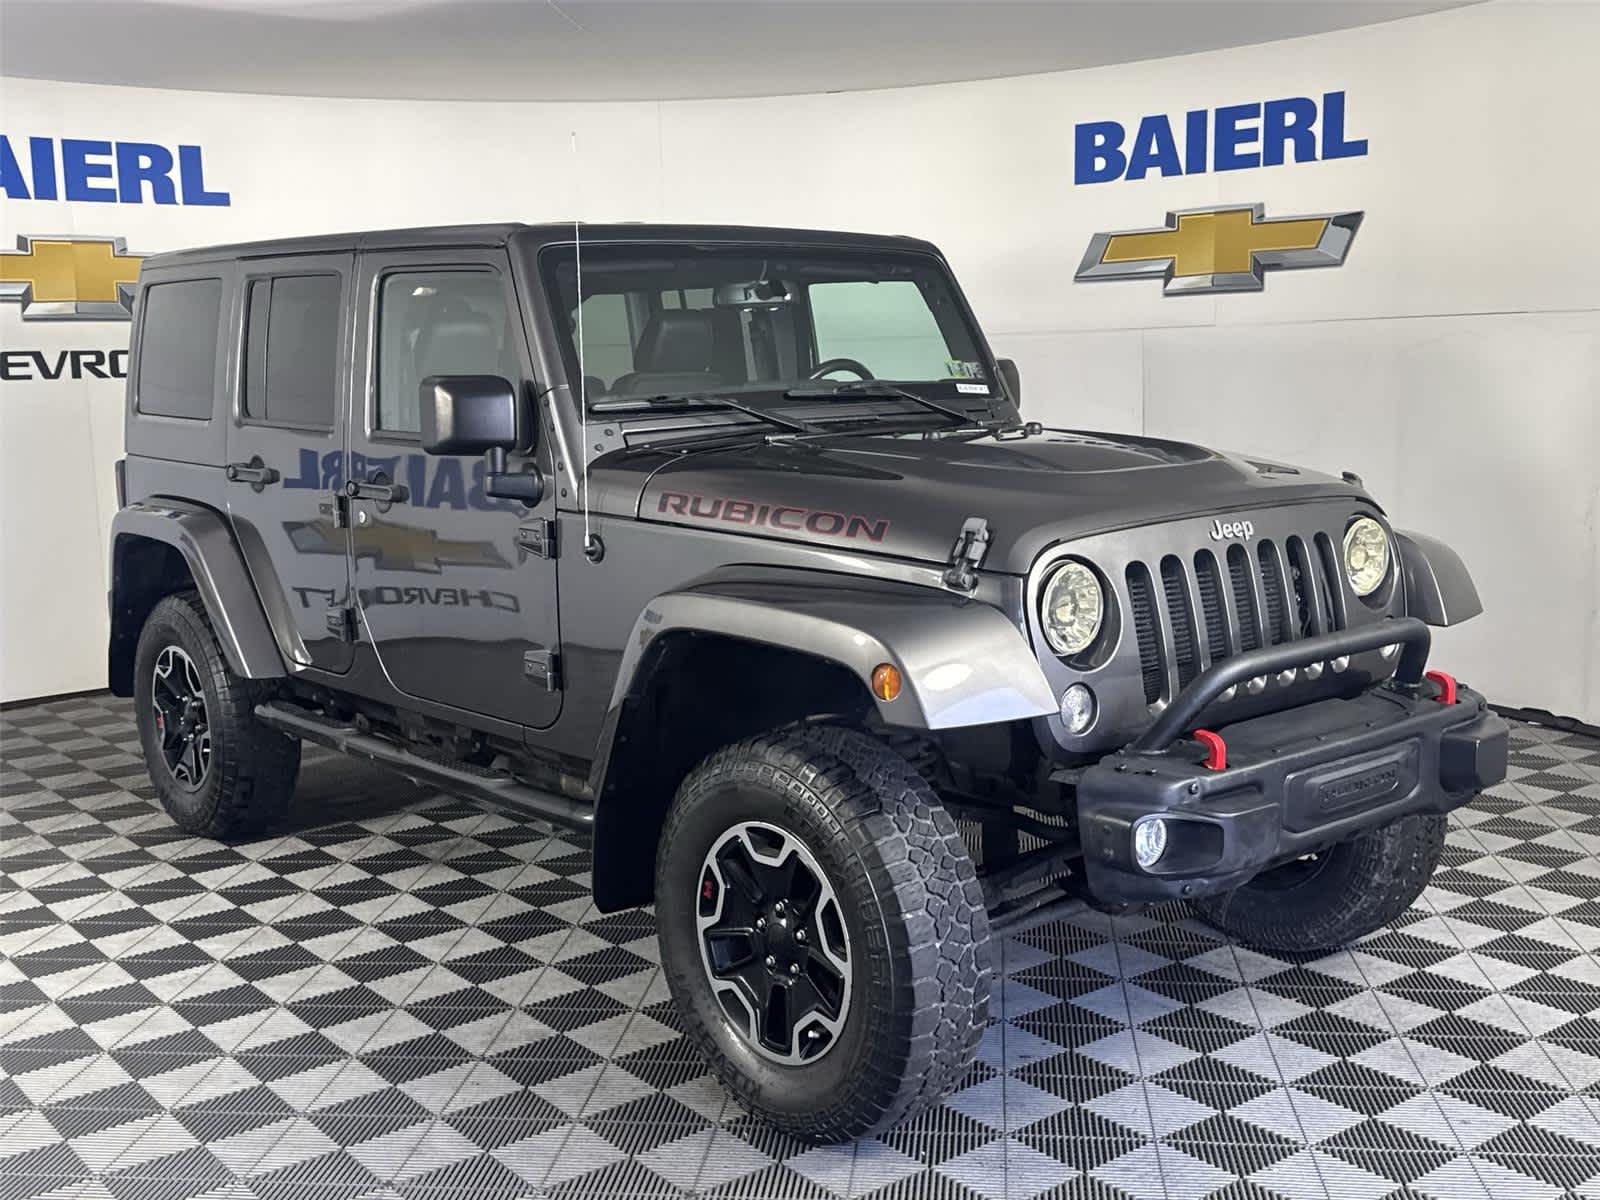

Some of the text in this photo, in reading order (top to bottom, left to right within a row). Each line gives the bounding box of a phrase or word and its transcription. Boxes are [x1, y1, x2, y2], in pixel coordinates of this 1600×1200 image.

[1074, 90, 1368, 185] BAIERL
[657, 492, 890, 543] RUBICON
[1208, 519, 1254, 541] Jeep
